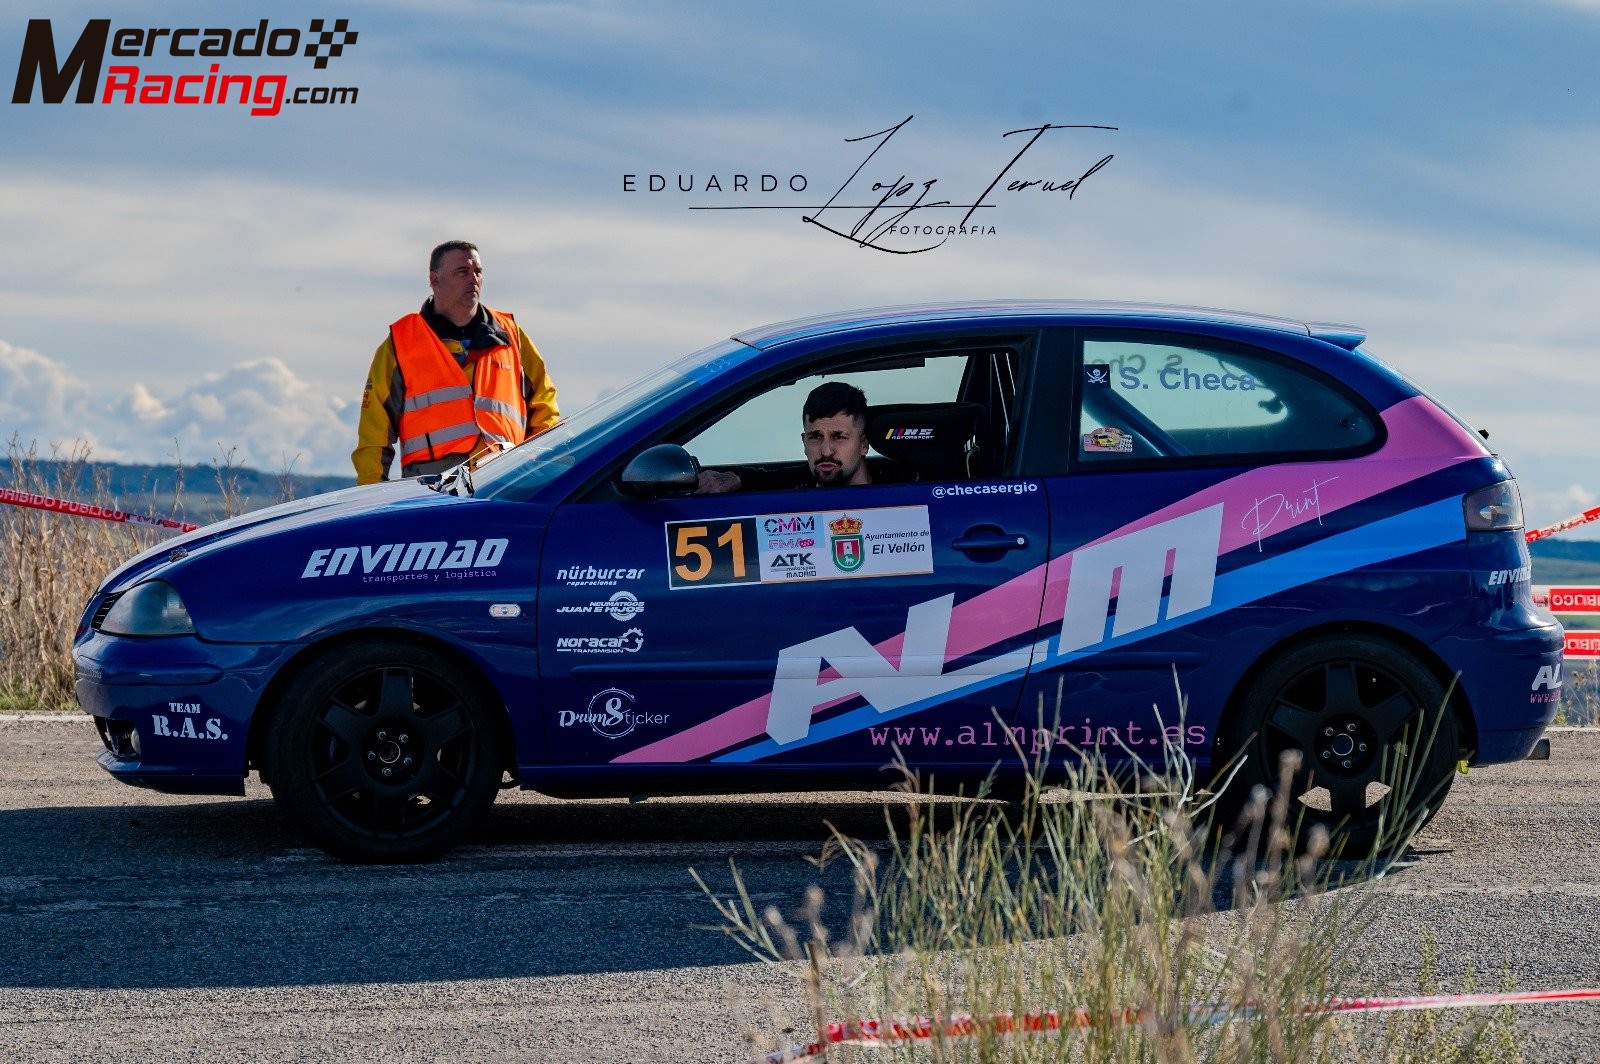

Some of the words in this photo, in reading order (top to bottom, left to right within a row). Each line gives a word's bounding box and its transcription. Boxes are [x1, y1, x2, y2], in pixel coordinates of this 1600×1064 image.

[1119, 366, 1149, 390] S.
[1159, 367, 1256, 391] Checa
[932, 482, 1038, 499] @checasergio
[59, 499, 124, 520] PUBLICO
[1241, 475, 1341, 553] Print
[763, 515, 815, 534] CMM
[864, 531, 918, 542] Ayuntamiento
[920, 529, 930, 537] de
[674, 522, 746, 582] 51
[872, 543, 885, 555] El
[888, 542, 925, 554] Vellón
[770, 552, 815, 568] ATK
[362, 572, 429, 584] transportes
[556, 565, 646, 580] nürburcar
[786, 571, 817, 579] MADRID
[1551, 593, 1600, 608] BLICO
[764, 501, 1225, 746] ALM
[168, 702, 201, 714] TEAM
[152, 714, 229, 741] R.A.S.
